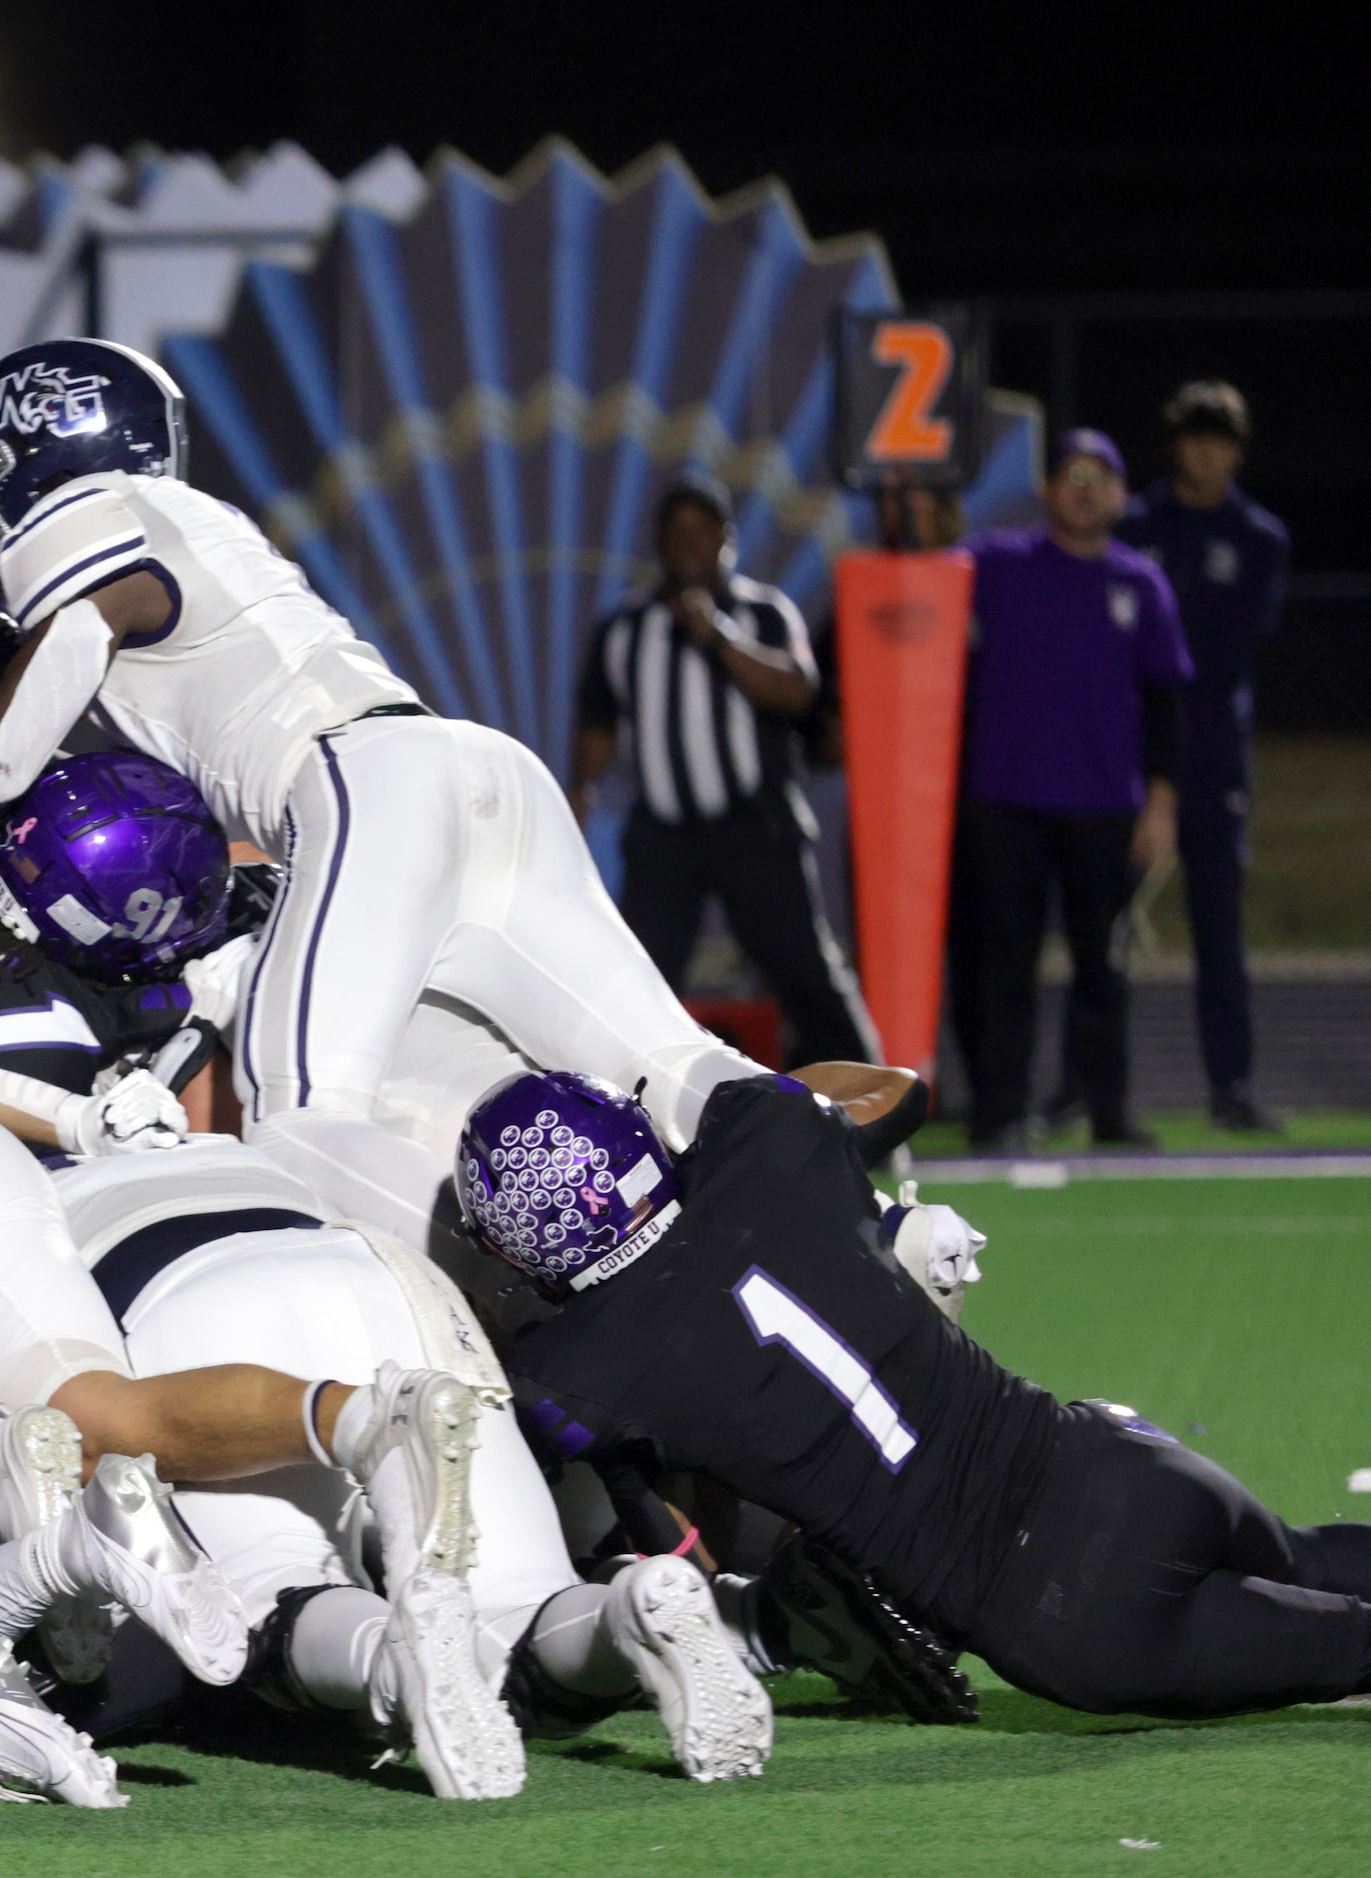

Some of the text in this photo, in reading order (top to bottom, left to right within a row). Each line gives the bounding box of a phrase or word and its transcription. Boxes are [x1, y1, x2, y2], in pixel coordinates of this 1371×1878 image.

[869, 321, 955, 461] 2
[112, 887, 184, 944] 91
[597, 1219, 661, 1274] COYOTE U
[730, 1262, 920, 1475] 1
